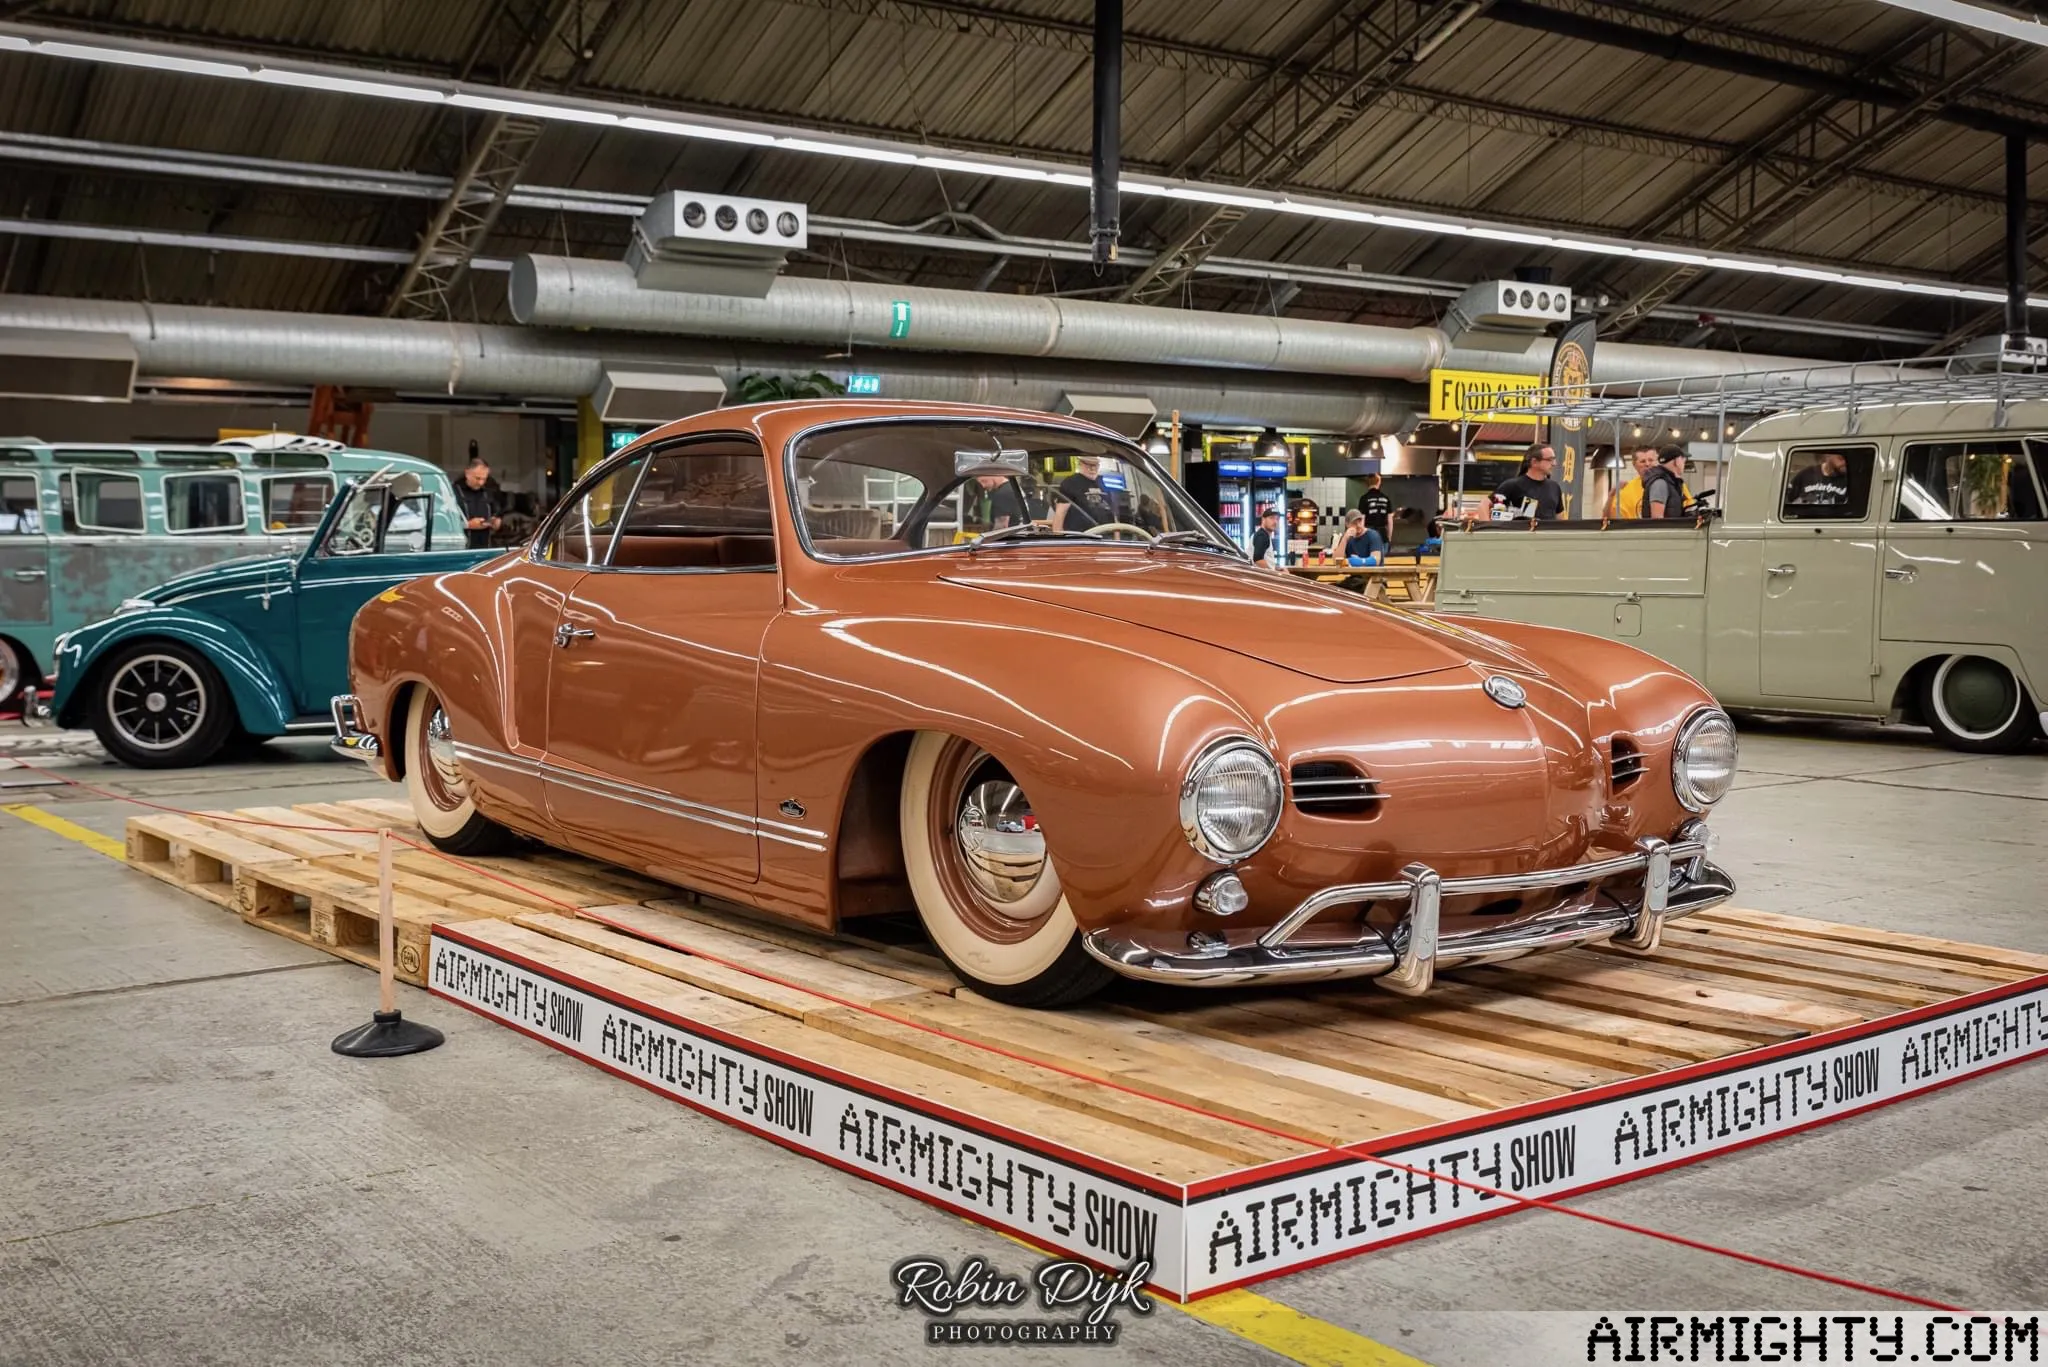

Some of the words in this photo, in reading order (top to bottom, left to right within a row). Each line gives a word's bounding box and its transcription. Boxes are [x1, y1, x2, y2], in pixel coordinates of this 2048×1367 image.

[1442, 379, 1491, 411] FOOD
[435, 947, 547, 1027] AIRMIGHTY
[550, 991, 584, 1043] SHOW
[602, 1014, 759, 1115] AIRMIGHTY
[765, 1074, 814, 1137] SHOW
[1615, 1061, 1828, 1166] AIRMIGHTY
[1834, 1047, 1880, 1104] SHOW
[840, 1103, 1076, 1237] AIRMIGHTY
[1085, 1188, 1158, 1266] SHOW
[1209, 1142, 1502, 1274] AIRMIGHTY
[1511, 1124, 1577, 1192] SHOW
